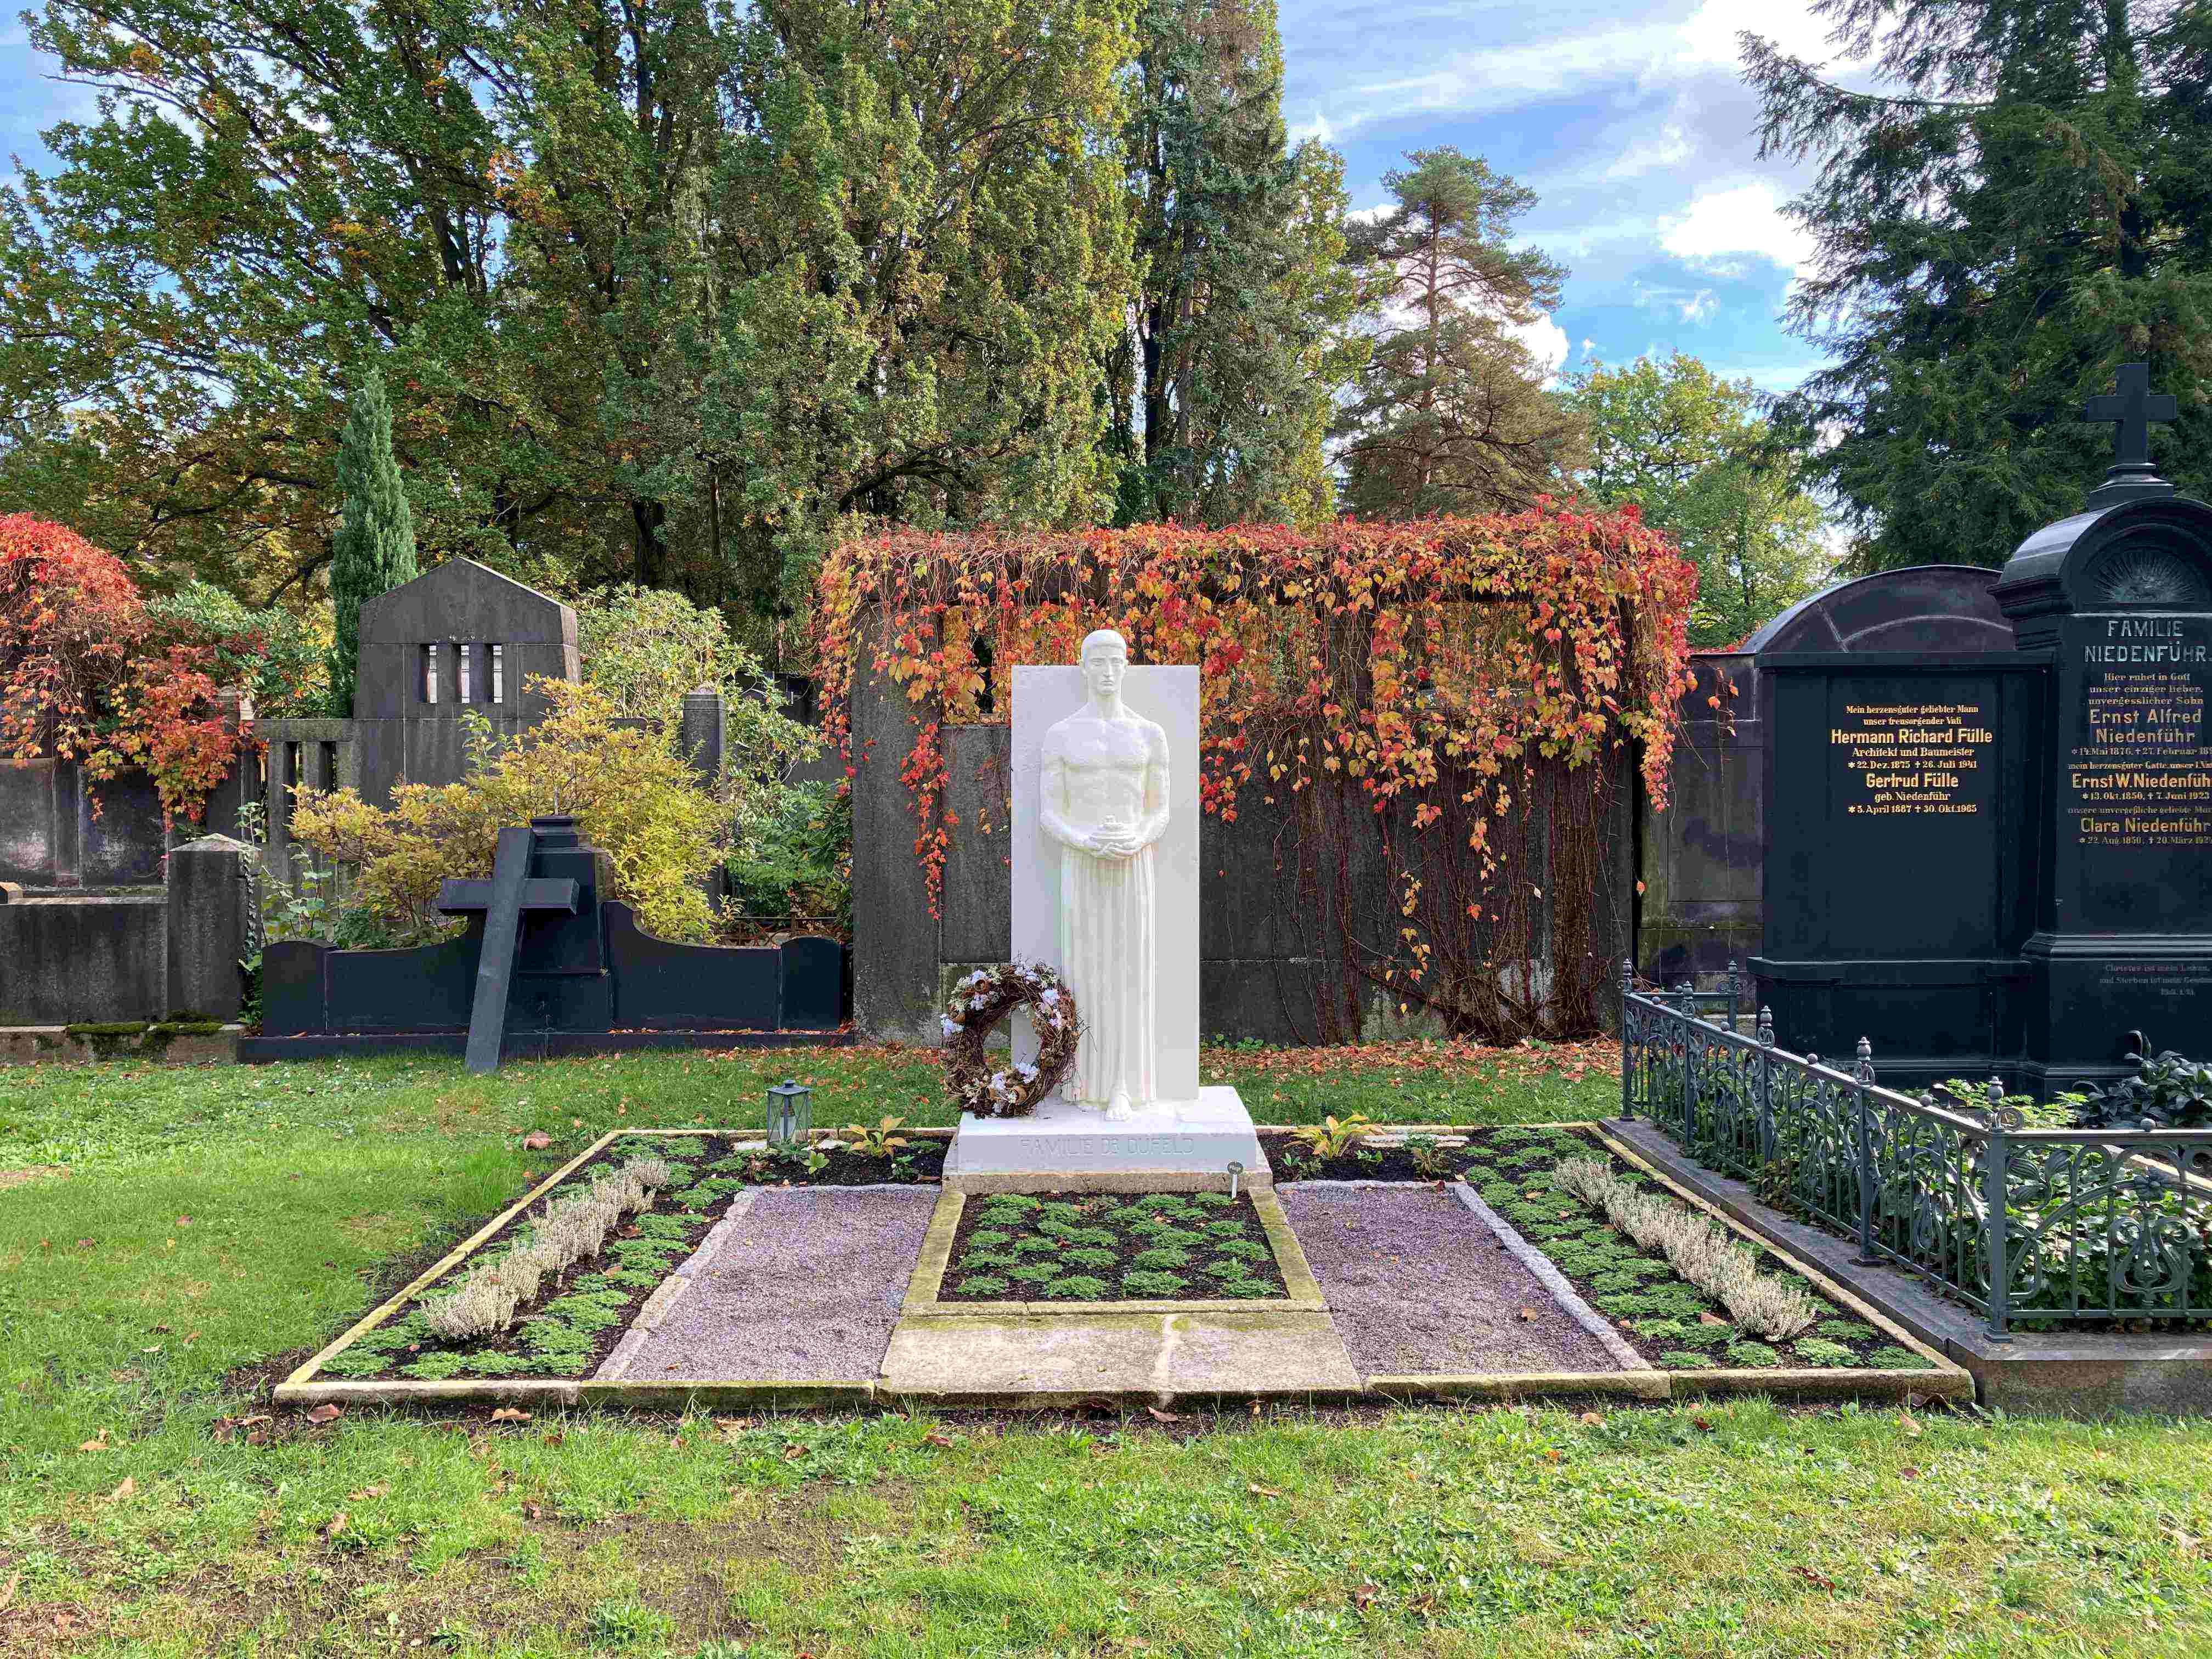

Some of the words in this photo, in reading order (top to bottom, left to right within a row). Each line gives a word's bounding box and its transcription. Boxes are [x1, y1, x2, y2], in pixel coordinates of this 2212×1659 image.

[2107, 620, 2184, 637] FAMILIE
[2085, 641, 2206, 662] NIEDENFÜHR
[2124, 685, 2166, 693] einziger
[2089, 697, 2172, 707] unvergesslicher
[1866, 706, 1918, 715] herzensguter
[1921, 705, 1955, 714] geliebter
[2090, 708, 2140, 724] Ernst
[2147, 708, 2202, 724] Alfred
[1946, 716, 1962, 725] Vati
[1831, 729, 1895, 744] Hermann
[1899, 728, 1953, 743] Richard
[1957, 728, 1993, 743] Fülle
[2096, 728, 2196, 743] Niedenführ
[1852, 748, 1898, 757] Architekt
[1900, 747, 1918, 757] und
[1920, 747, 1974, 757] Baumeister
[2157, 747, 2197, 755] Februar
[1866, 772, 1918, 788] Gertrud
[1924, 772, 1959, 787] Fülle
[2073, 772, 2114, 788] Ernst
[2115, 772, 2133, 788] W.
[1875, 792, 1894, 803] geb.
[1895, 792, 1951, 800] Niedenführ
[1865, 804, 1889, 815] April
[1891, 804, 1912, 813] 1887
[2081, 817, 2119, 832] Clara
[2124, 817, 2211, 832] Niedenführ
[1020, 1137, 1093, 1156] FAMILIE
